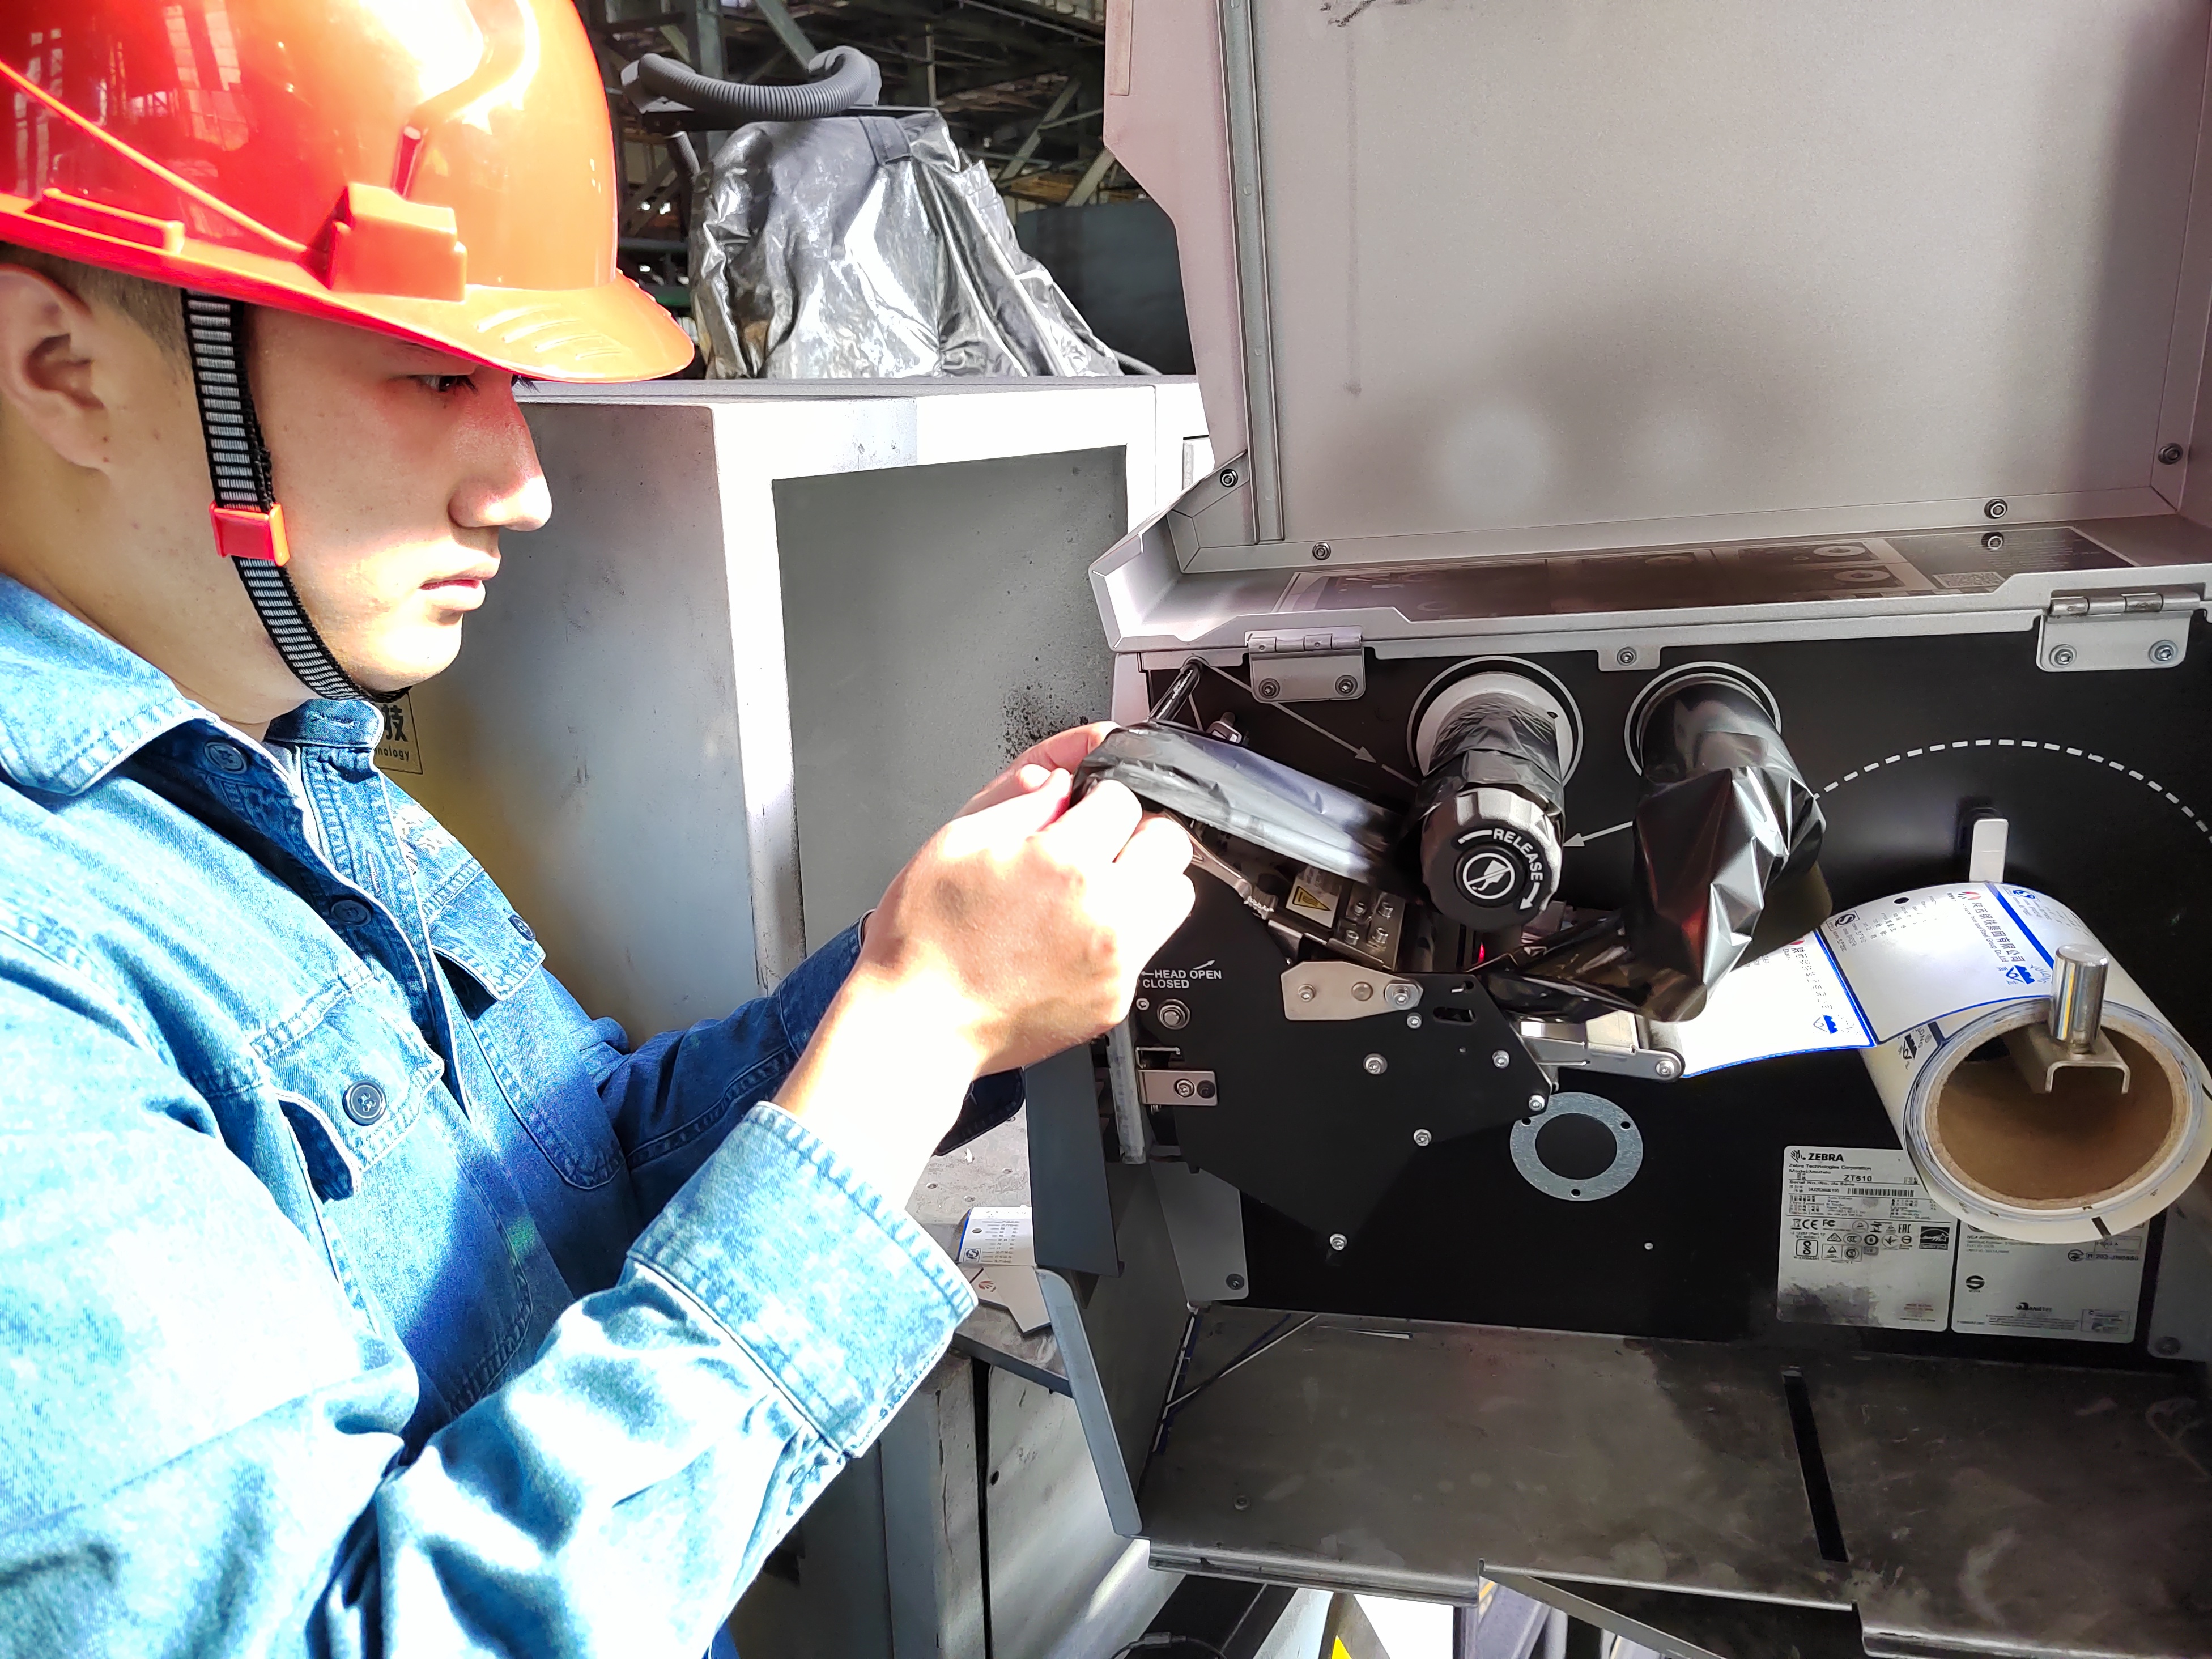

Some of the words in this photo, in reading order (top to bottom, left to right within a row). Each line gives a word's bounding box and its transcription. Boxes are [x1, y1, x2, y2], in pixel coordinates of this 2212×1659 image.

[376, 745, 410, 762] nology
[1492, 828, 1543, 881] RELEASE
[1154, 969, 1186, 979] HEAD
[1189, 969, 1222, 979] OPEN
[1142, 979, 1189, 988] CLOSED
[1807, 1152, 1844, 1162] ZEBRA
